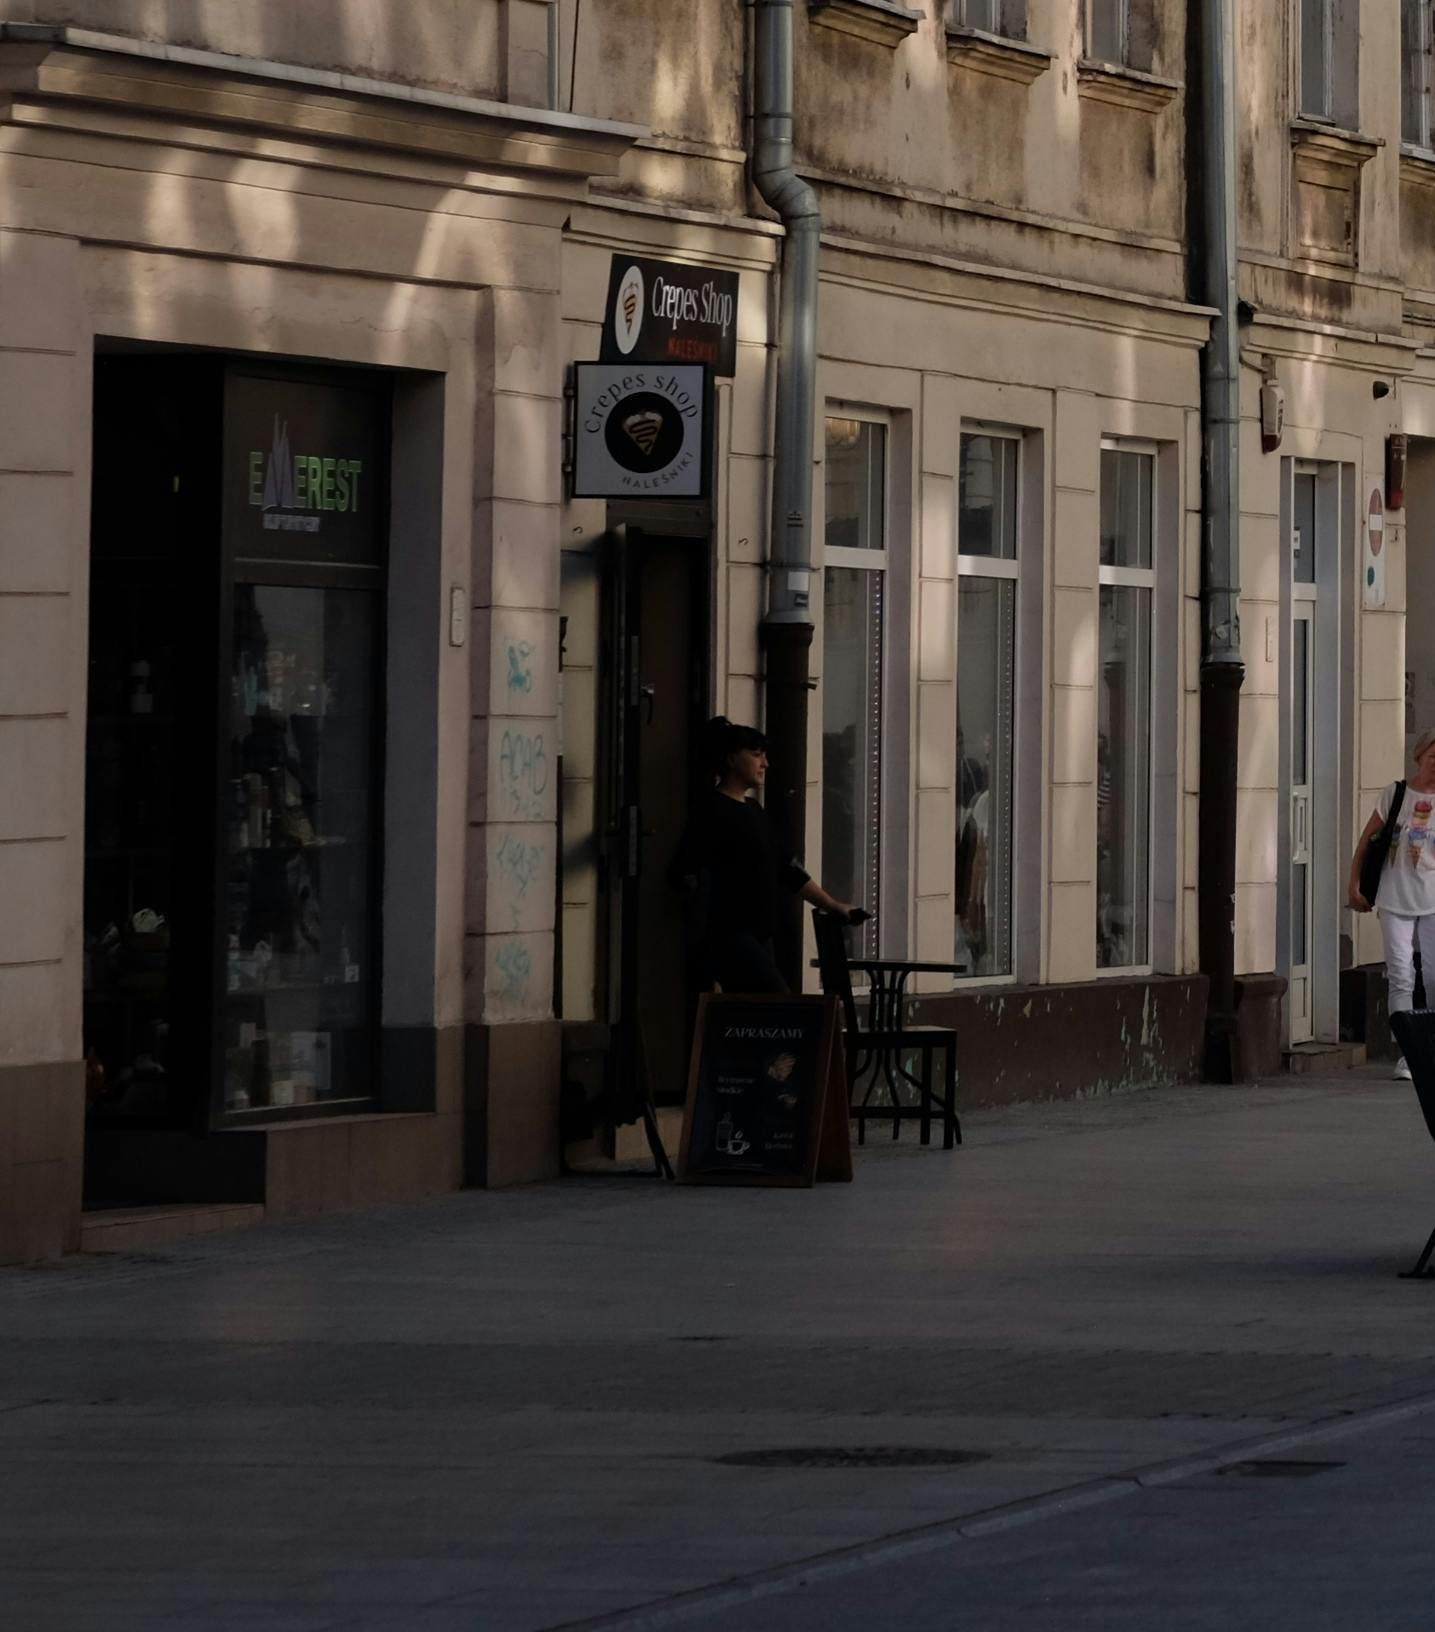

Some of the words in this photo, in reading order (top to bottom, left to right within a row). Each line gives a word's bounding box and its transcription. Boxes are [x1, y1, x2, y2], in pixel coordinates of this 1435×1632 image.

[652, 276, 698, 330] Crepes
[700, 280, 732, 336] Shop
[585, 373, 646, 434] Crepes
[654, 374, 698, 419] shop
[621, 451, 694, 489] NALEŚNIKI
[724, 1026, 806, 1039] ZAPRASZAMY
